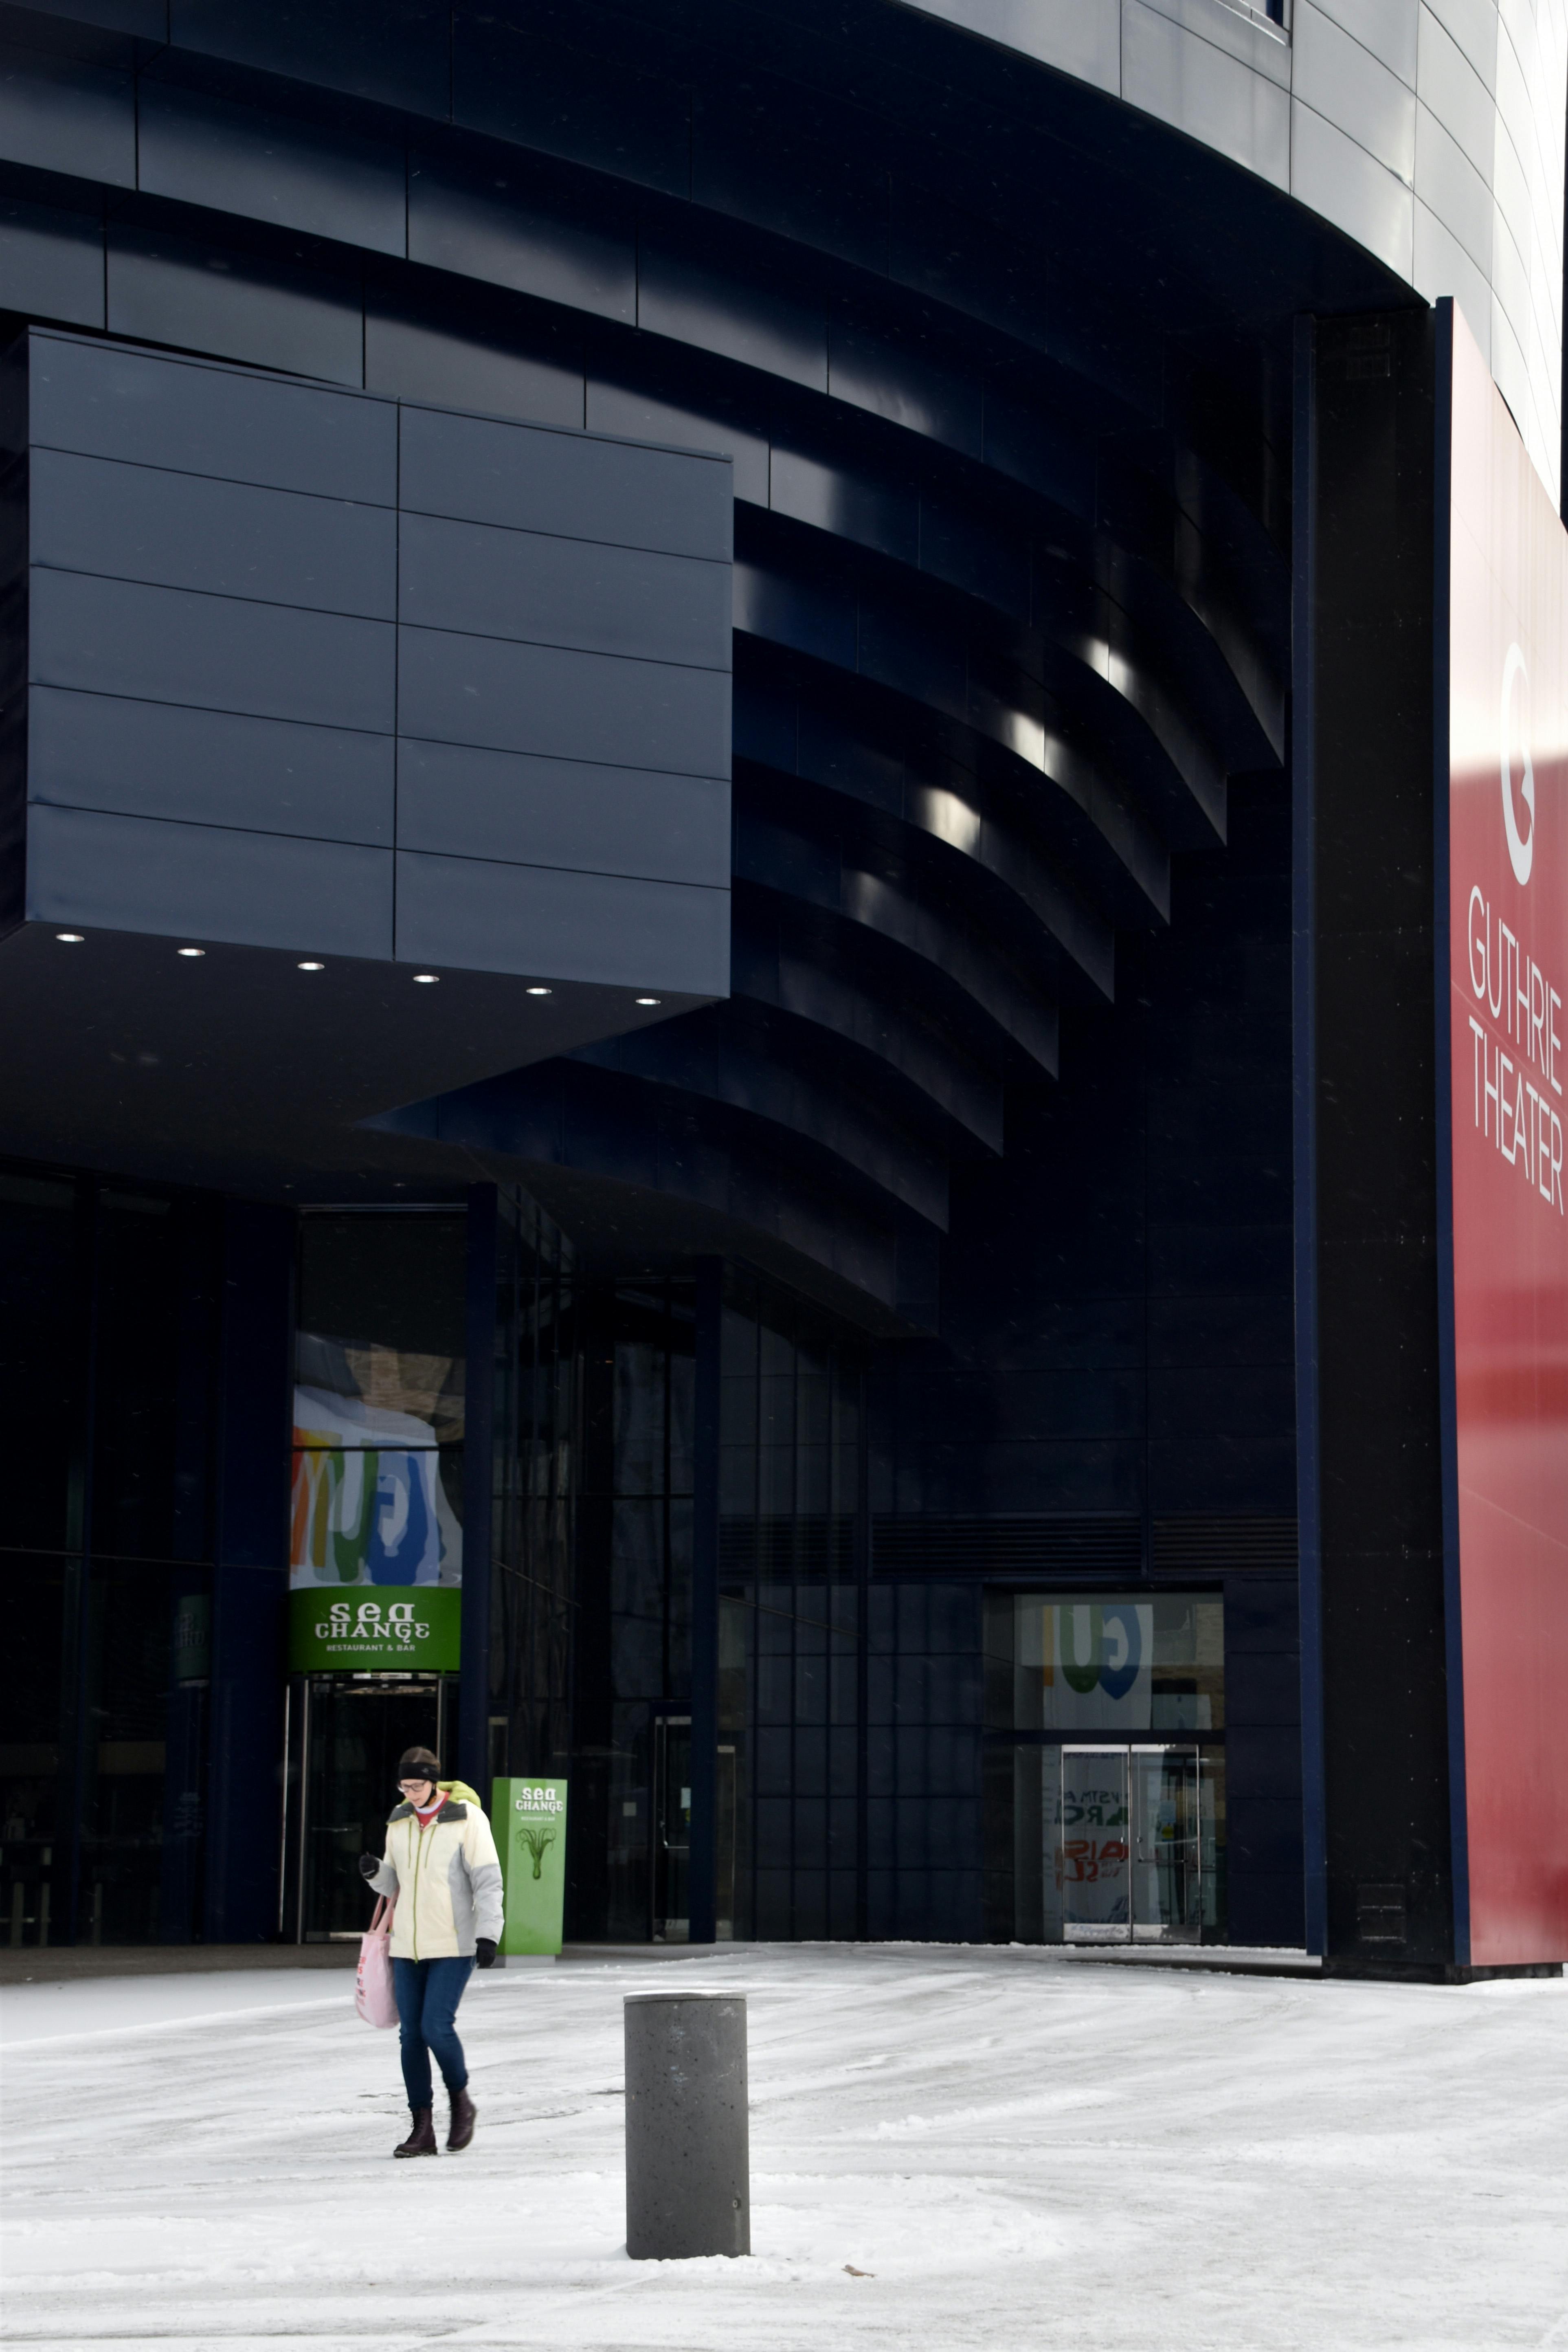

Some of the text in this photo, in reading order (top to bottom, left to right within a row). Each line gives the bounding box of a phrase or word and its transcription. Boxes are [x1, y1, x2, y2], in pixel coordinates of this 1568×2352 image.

[1469, 885, 1561, 1096] GUTHRIE
[1469, 1015, 1563, 1216] THEATER
[329, 1603, 415, 1622] sea
[315, 1622, 430, 1643] CHANGE
[522, 1787, 556, 1800] sea
[516, 1800, 563, 1814] CHANGE
